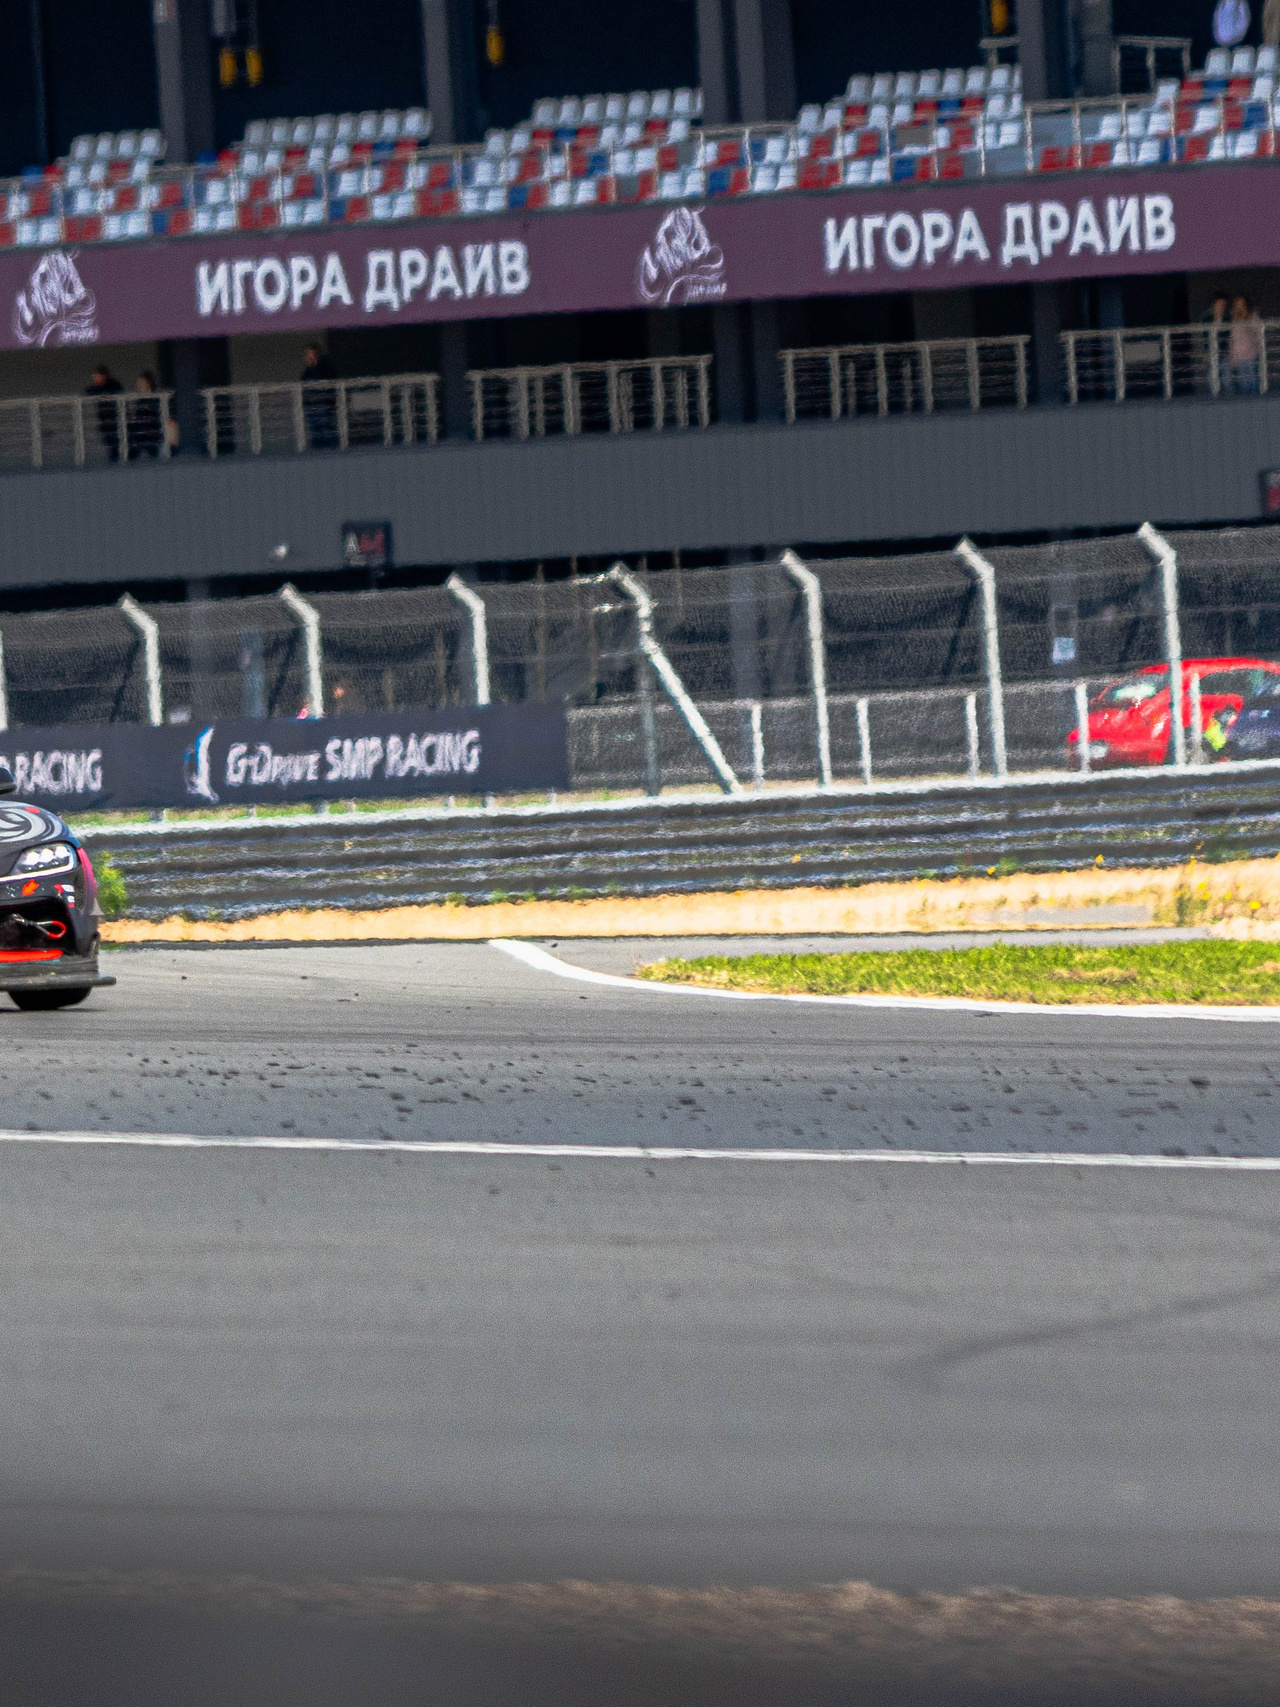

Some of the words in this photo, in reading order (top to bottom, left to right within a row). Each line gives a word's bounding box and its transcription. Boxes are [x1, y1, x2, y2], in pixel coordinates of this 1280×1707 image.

[825, 206, 991, 273] ИГОРА
[1001, 194, 1175, 267] ДРАЙВ
[196, 252, 353, 316] ИГОРА
[363, 240, 530, 312] ДРАЙВ
[14, 748, 103, 795] RACING
[325, 736, 383, 781] SMP
[385, 730, 481, 779] RACING
